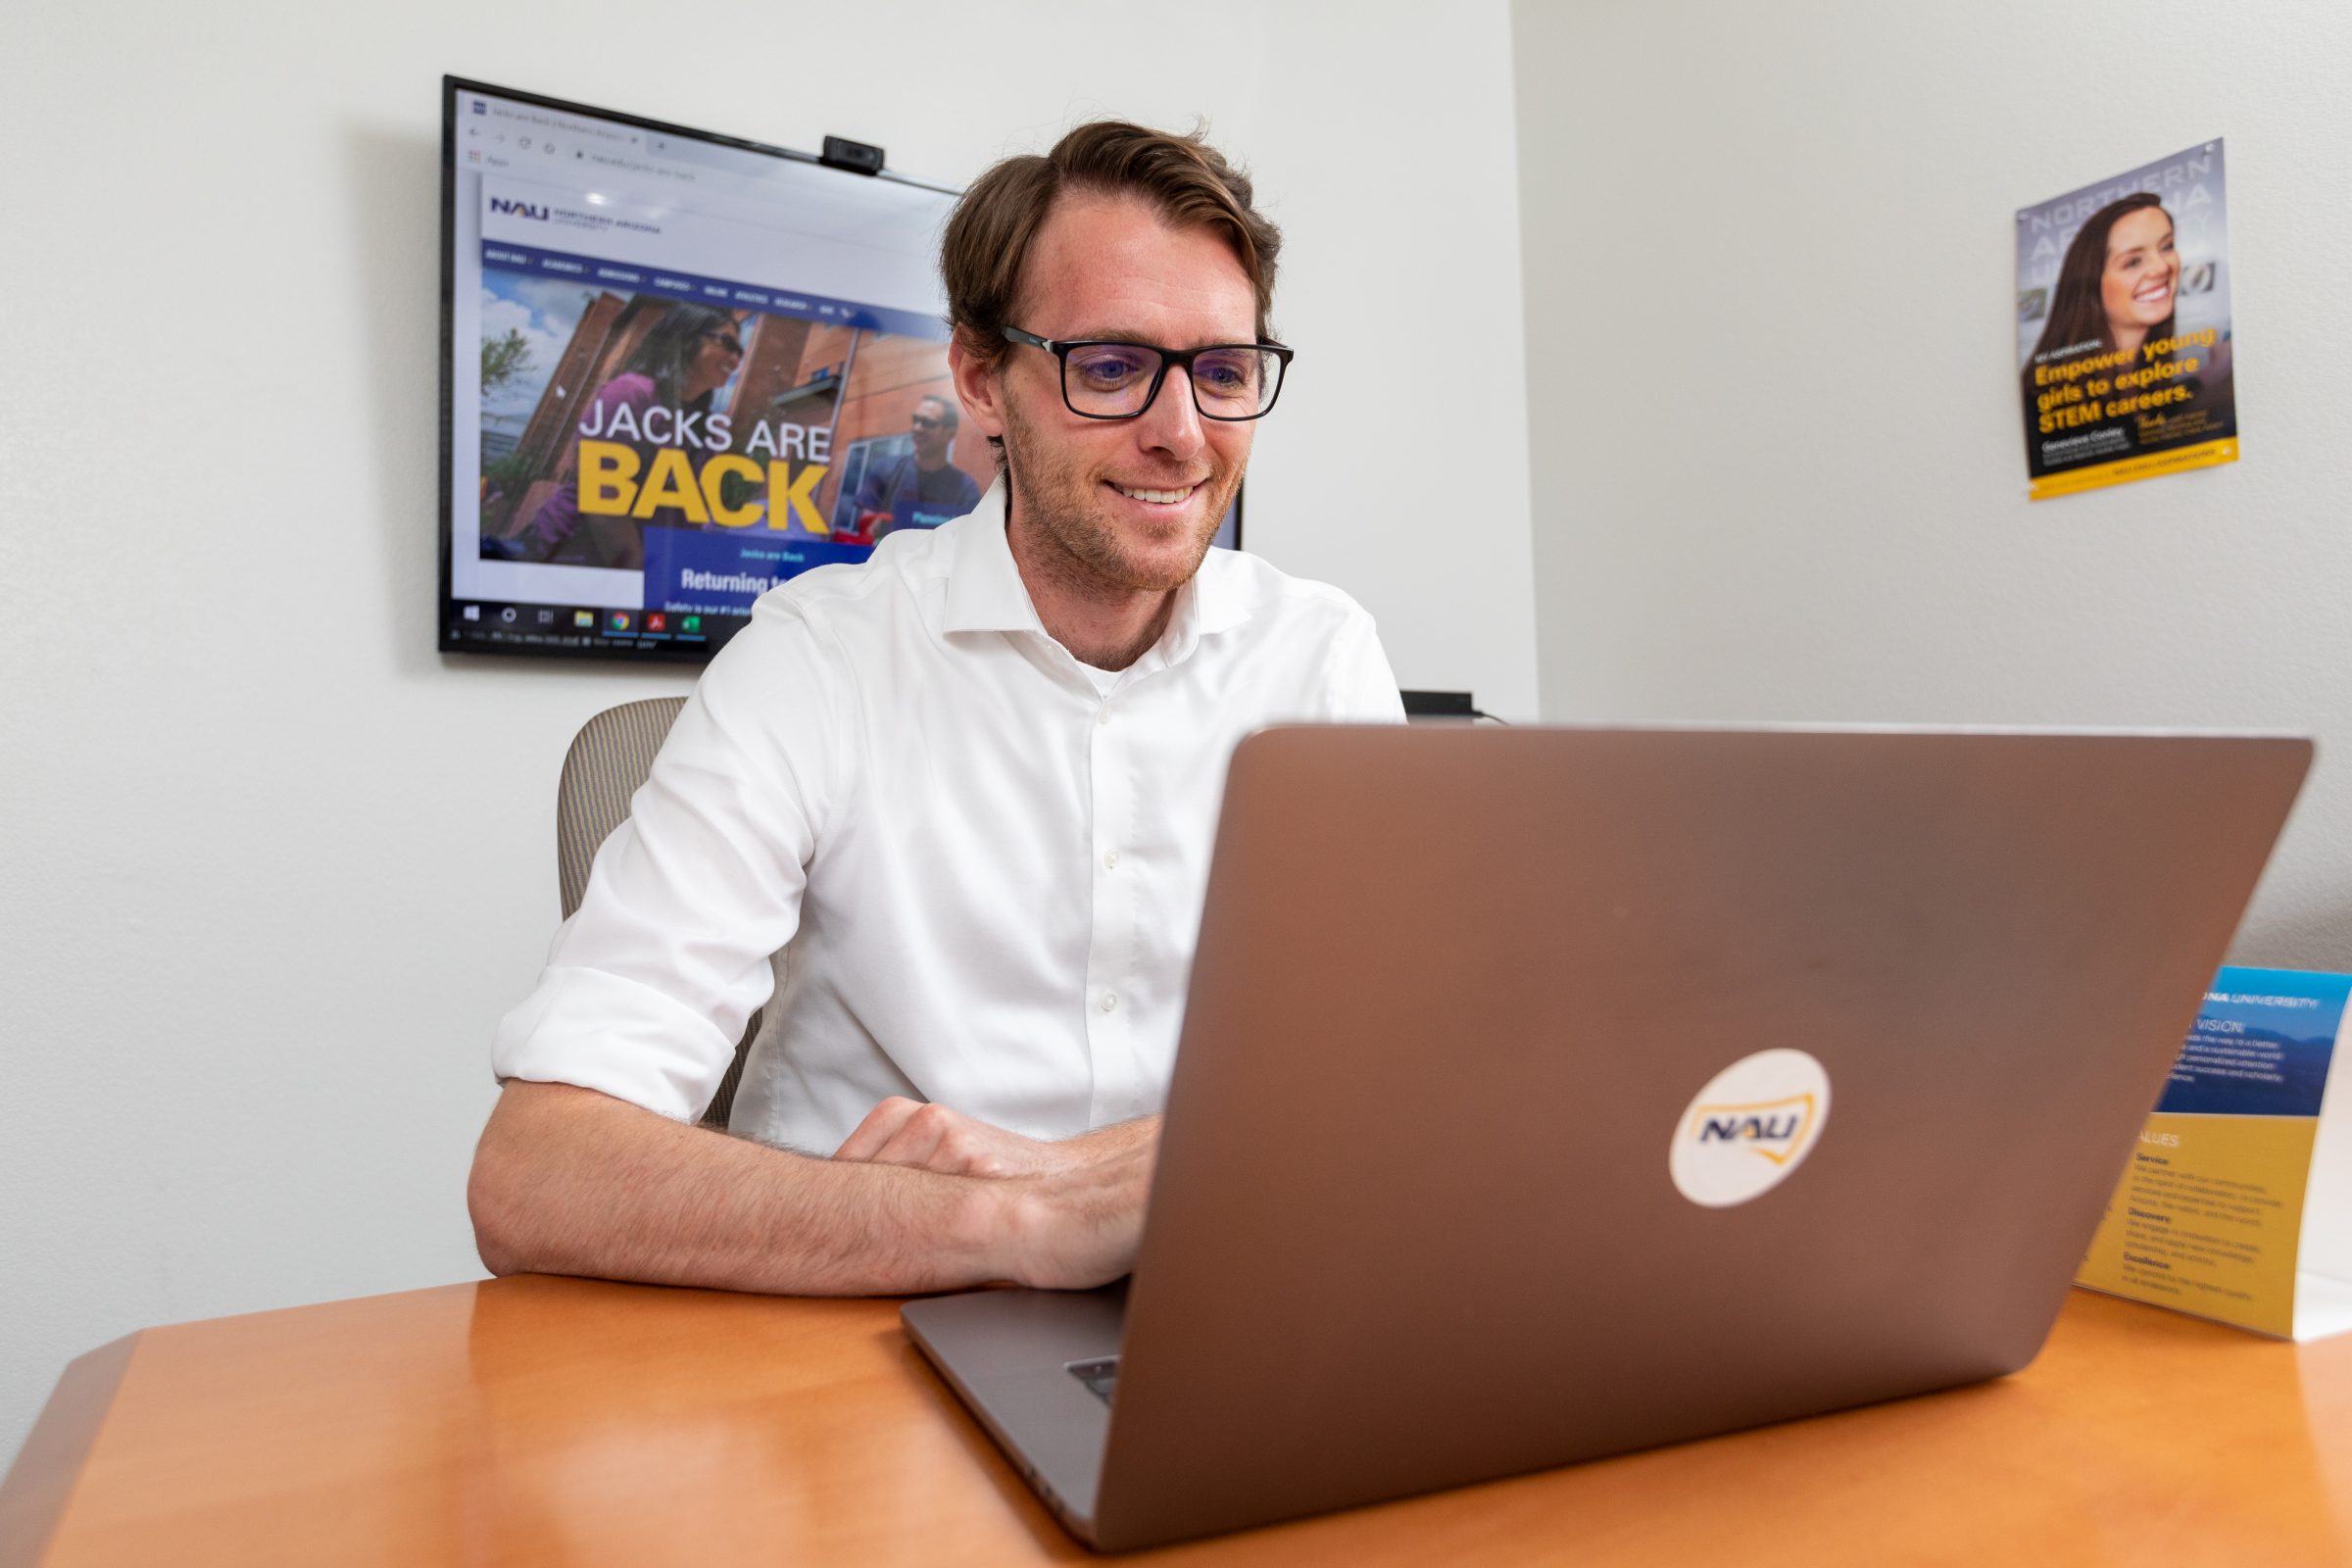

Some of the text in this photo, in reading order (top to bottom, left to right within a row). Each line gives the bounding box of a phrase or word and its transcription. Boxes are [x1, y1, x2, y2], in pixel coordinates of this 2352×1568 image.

[490, 197, 550, 221] NAU
[2031, 156, 2212, 233] NORTHERN
[2034, 328, 2217, 386] Empower young
[2036, 357, 2199, 413] girls to explore
[2038, 400, 2102, 434] STEM
[2105, 383, 2195, 418] careers.
[578, 399, 832, 463] JACKS ARE
[577, 439, 830, 535] BACK
[681, 567, 769, 597] Returning
[2196, 1018, 2244, 1033] VISION
[2230, 994, 2320, 1008] UNIVERSITY
[1699, 1113, 1799, 1145] NAU
